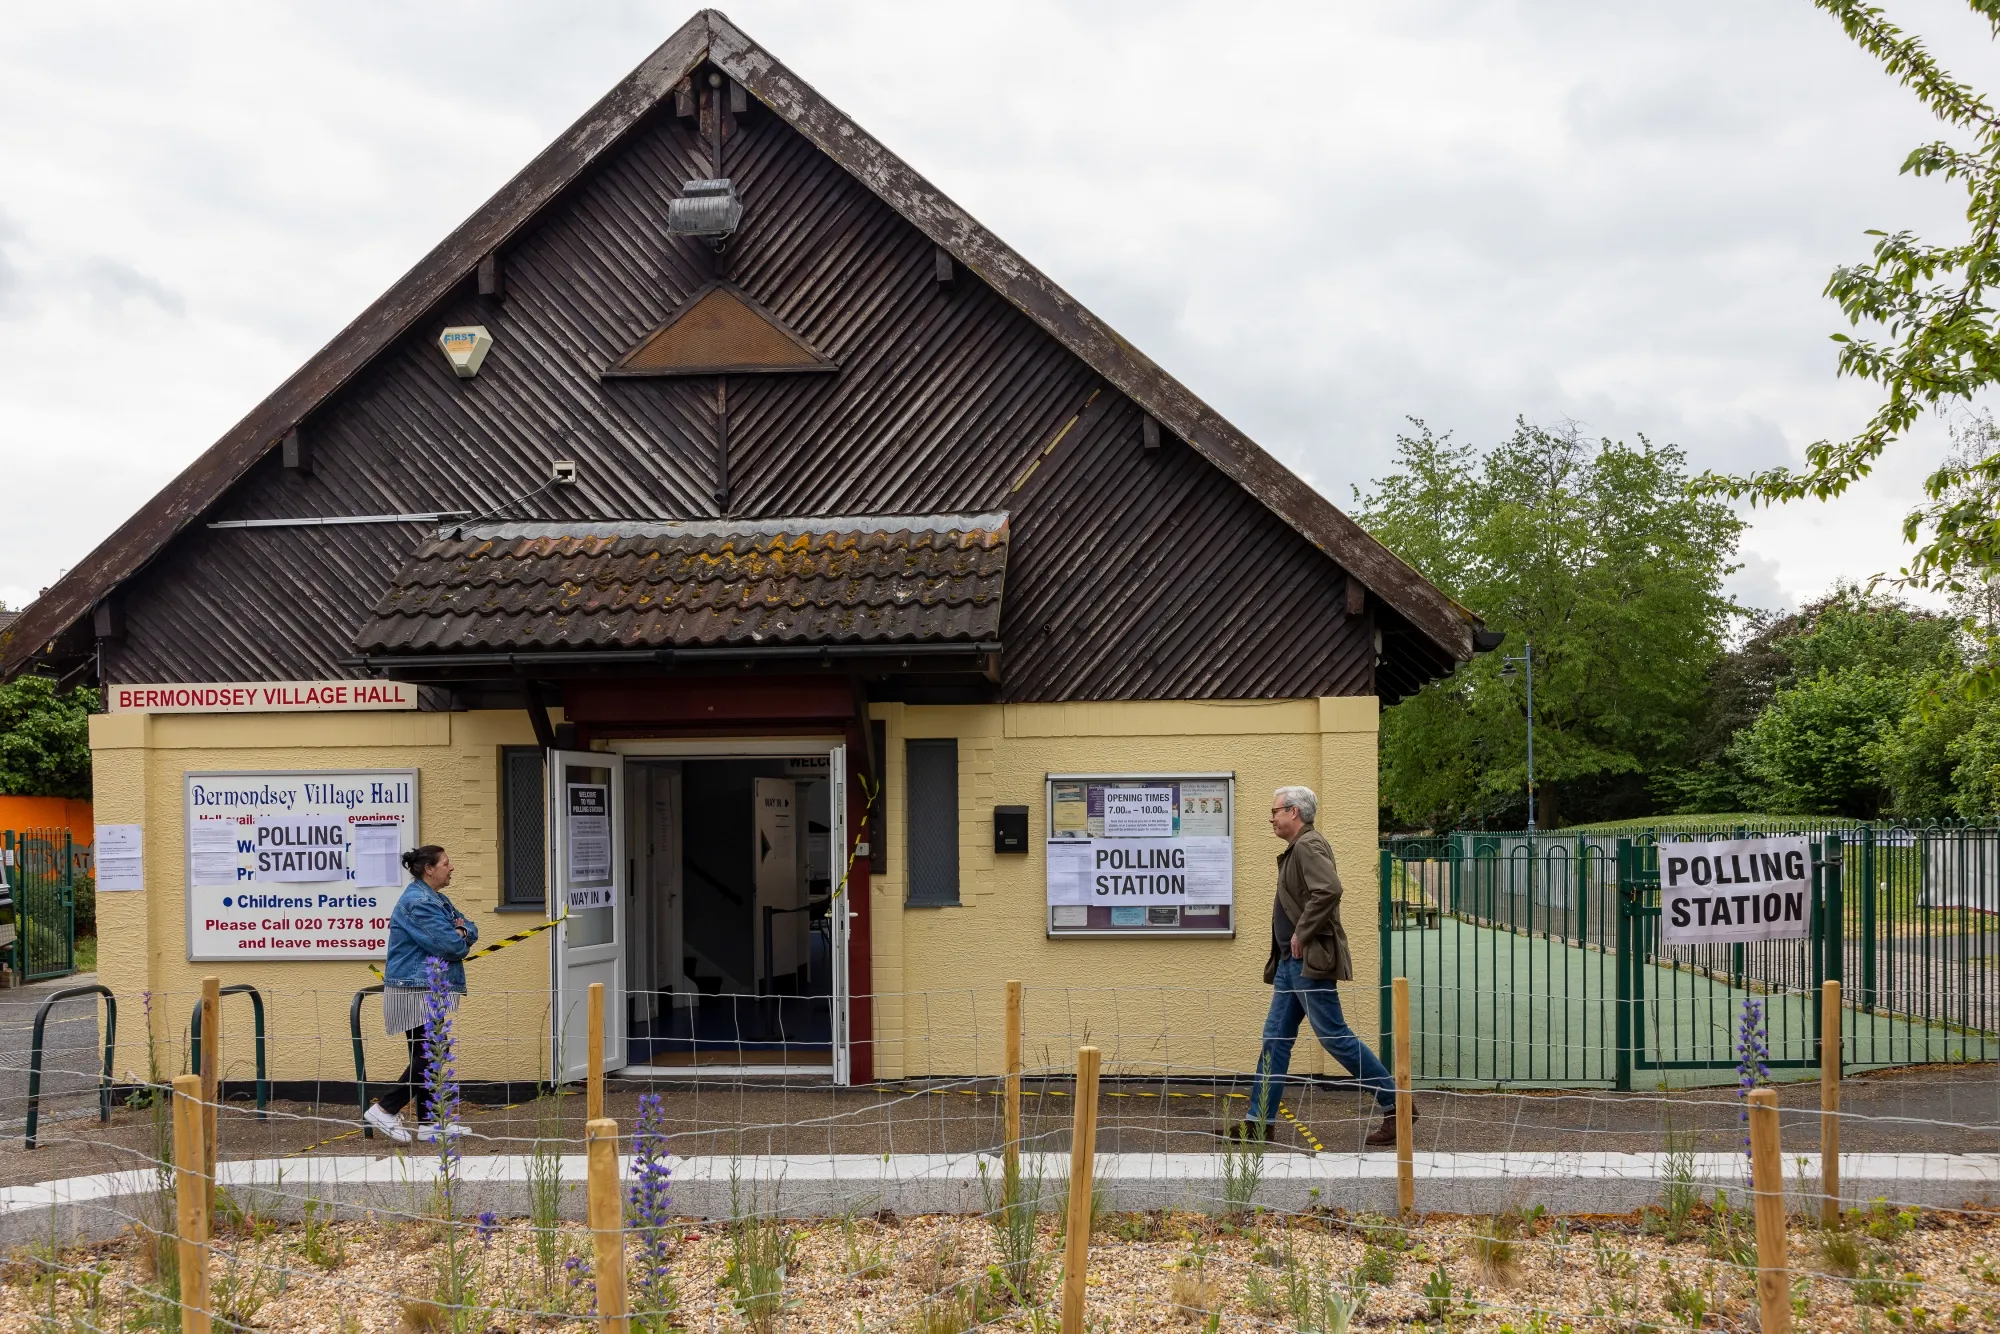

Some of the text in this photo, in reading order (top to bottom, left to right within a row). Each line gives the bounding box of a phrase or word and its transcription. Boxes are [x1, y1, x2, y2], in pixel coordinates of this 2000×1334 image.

[444, 333, 476, 345] FIRST
[119, 685, 406, 708] BERMONDSEY VILLAGE HALL
[191, 782, 410, 811] Bermondsey Village Hall
[1107, 793, 1170, 803] OPENING TIMES
[257, 825, 343, 847] POLLING
[257, 850, 343, 872] STATION
[1096, 848, 1185, 870] POLLING
[1667, 850, 1805, 887] POLLING
[1095, 874, 1185, 895] STATION
[237, 894, 377, 909] Childrens Parties
[570, 890, 600, 906] WAY IN
[1671, 892, 1803, 928] STATION
[205, 917, 392, 931] Please Call 020 7378 107
[238, 936, 386, 951] and leave message
